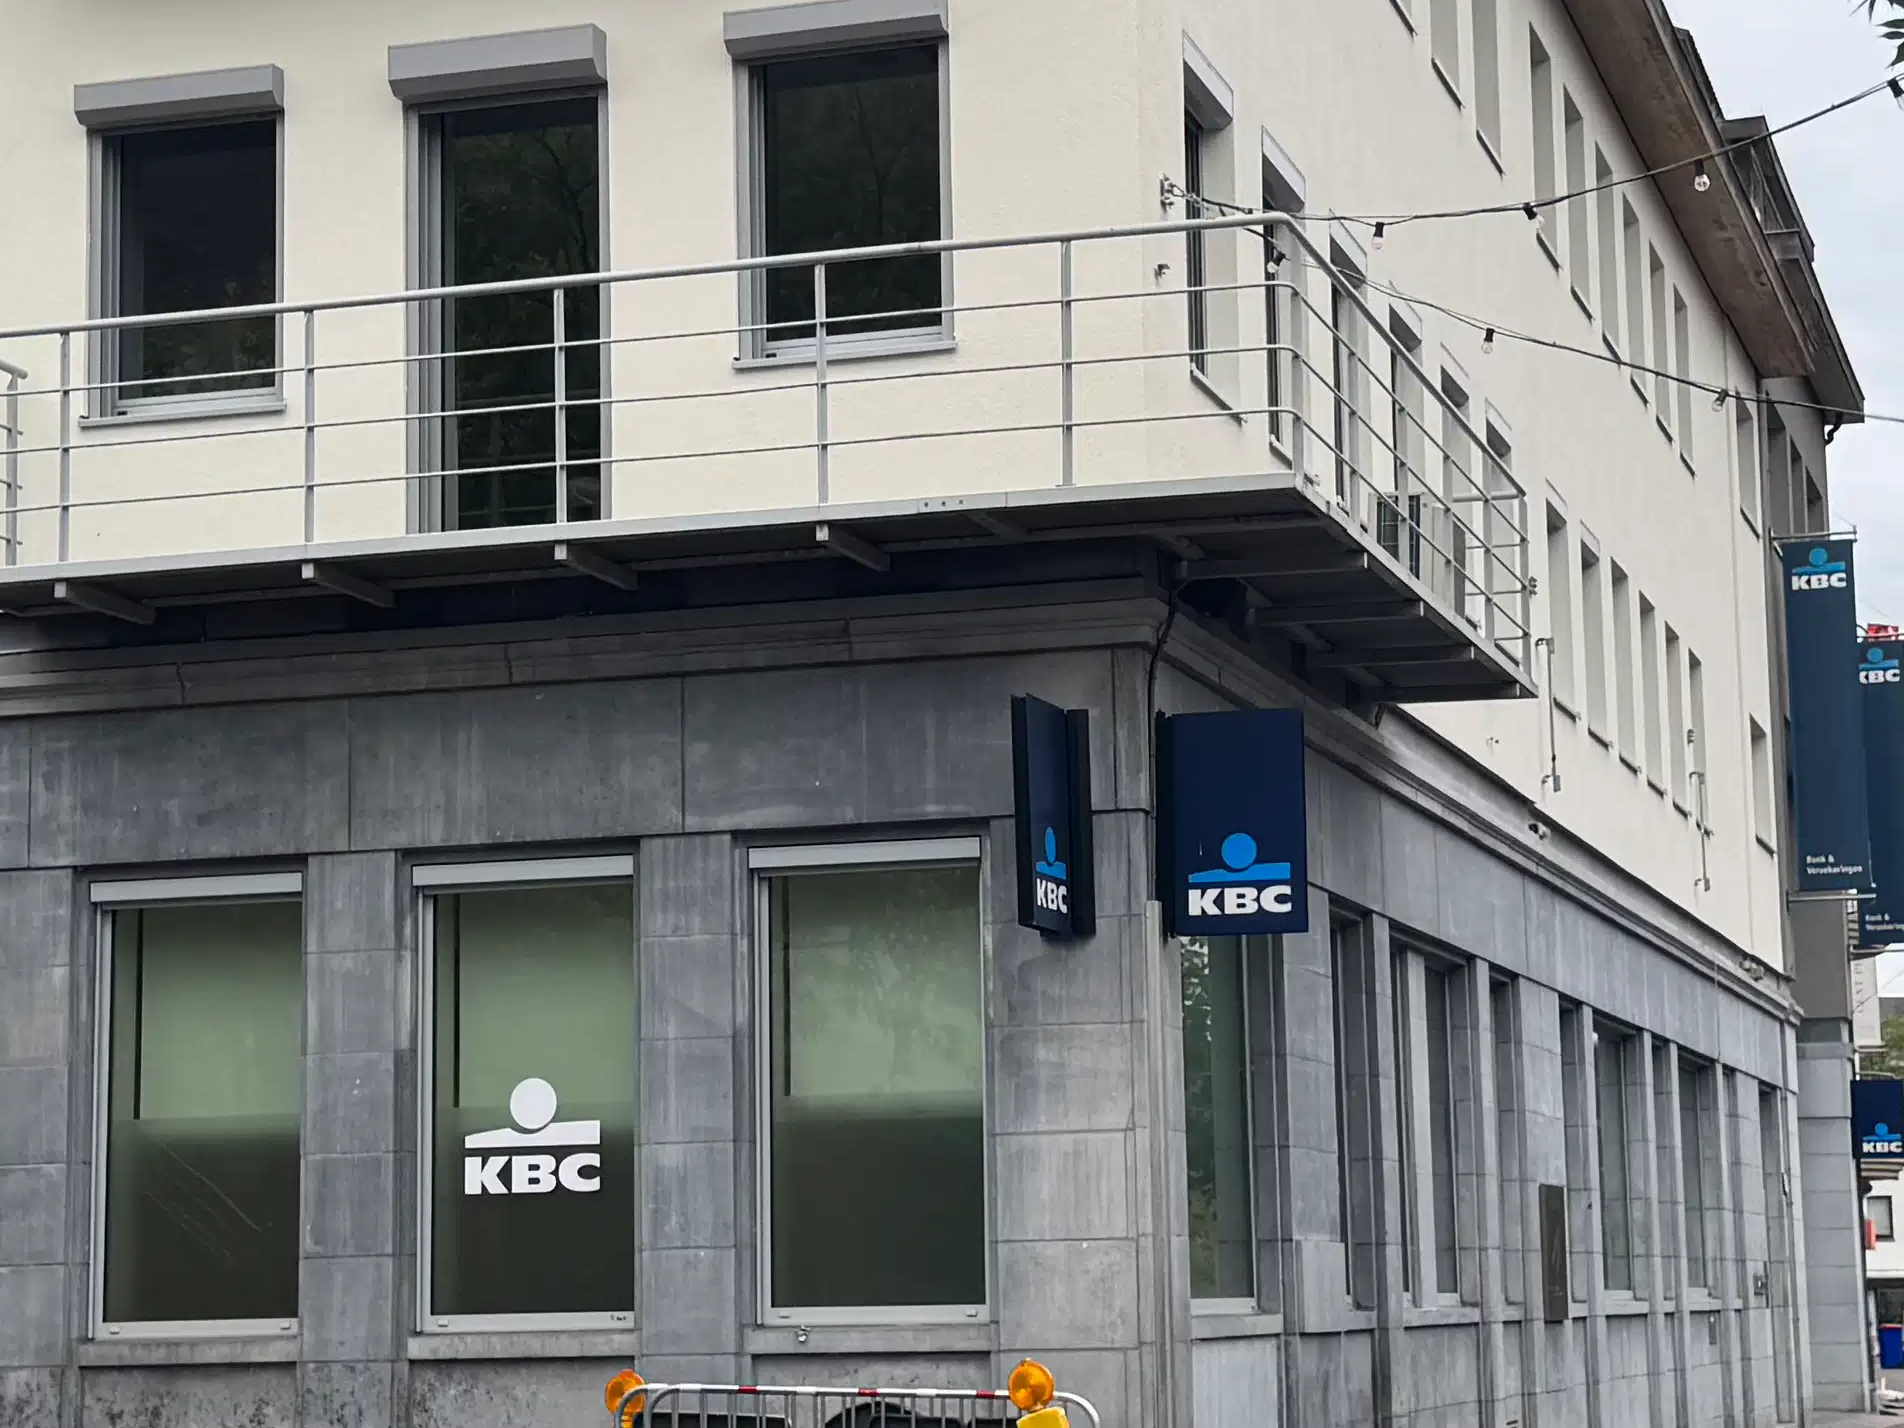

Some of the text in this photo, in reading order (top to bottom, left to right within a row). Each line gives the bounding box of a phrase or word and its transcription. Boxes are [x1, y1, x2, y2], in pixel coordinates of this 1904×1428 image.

[1791, 572, 1848, 591] KBC
[1035, 877, 1069, 914] KBC
[1188, 884, 1293, 917] KBC
[1862, 1141, 1903, 1154] KBC
[464, 1152, 601, 1195] KBC
